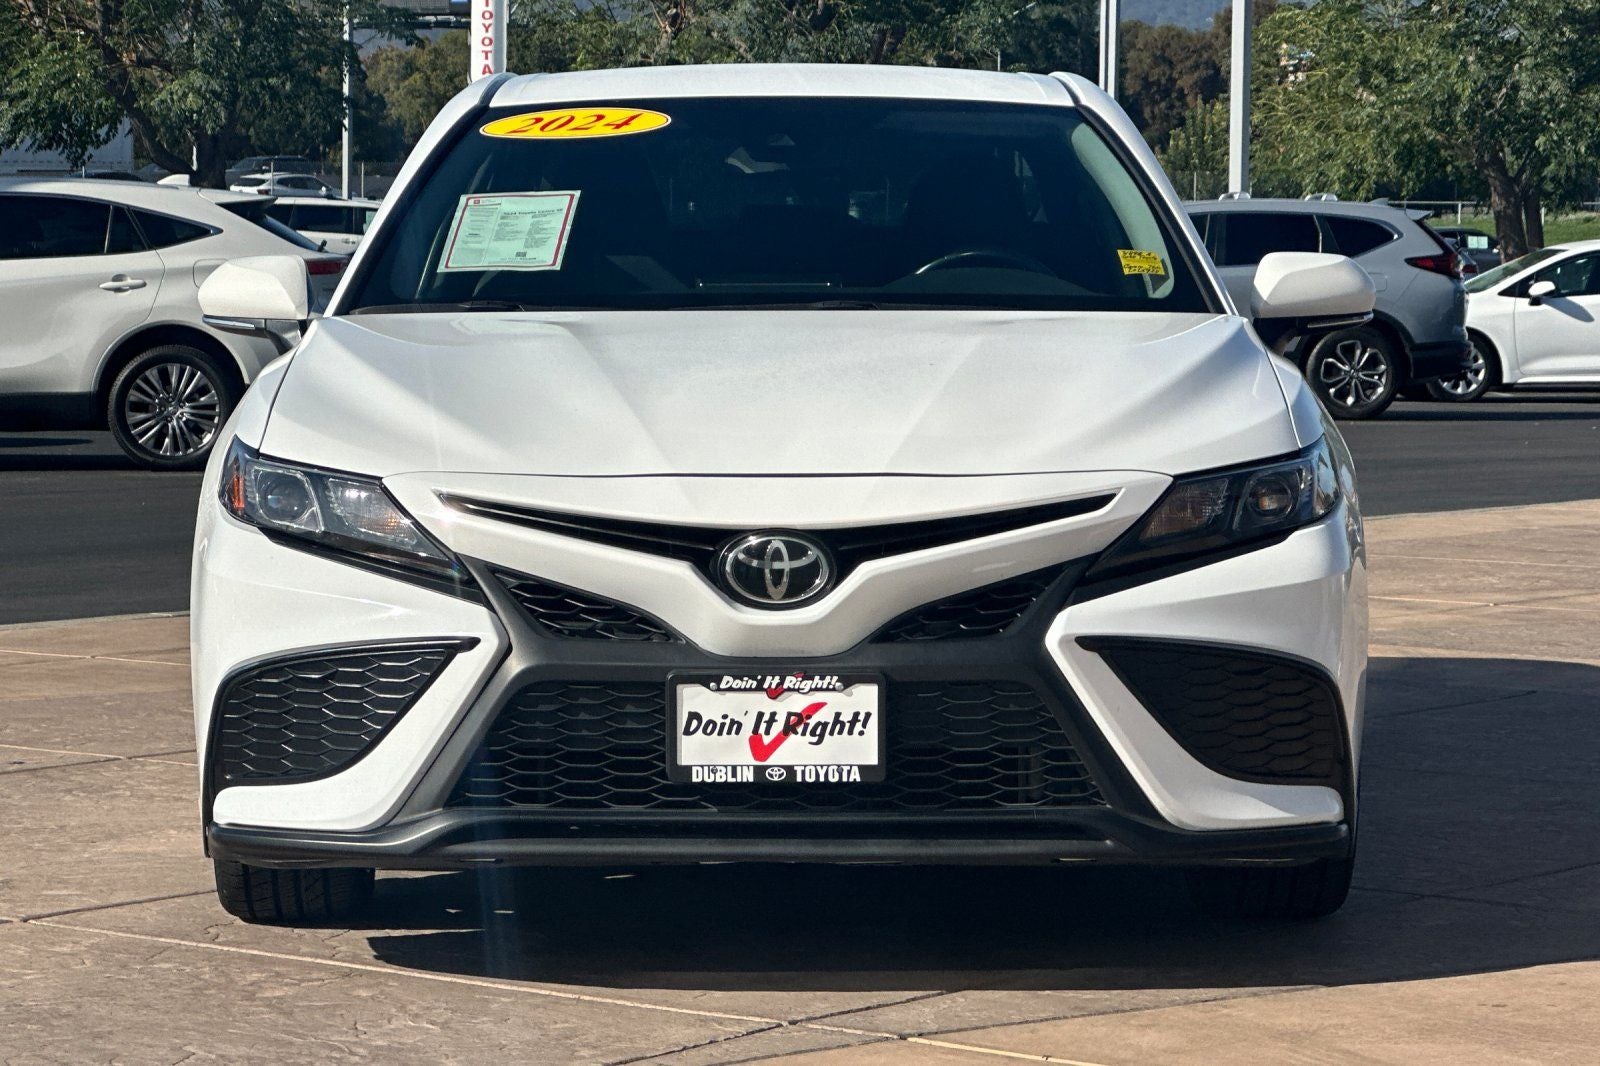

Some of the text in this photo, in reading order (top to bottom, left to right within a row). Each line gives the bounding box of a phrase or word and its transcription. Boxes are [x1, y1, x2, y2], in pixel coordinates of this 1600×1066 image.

[505, 112, 645, 134] 2024
[719, 674, 839, 694] Doin' It Right!
[682, 710, 873, 746] Doin' It Right!
[691, 765, 861, 783] DUBLIN TOYOTA
